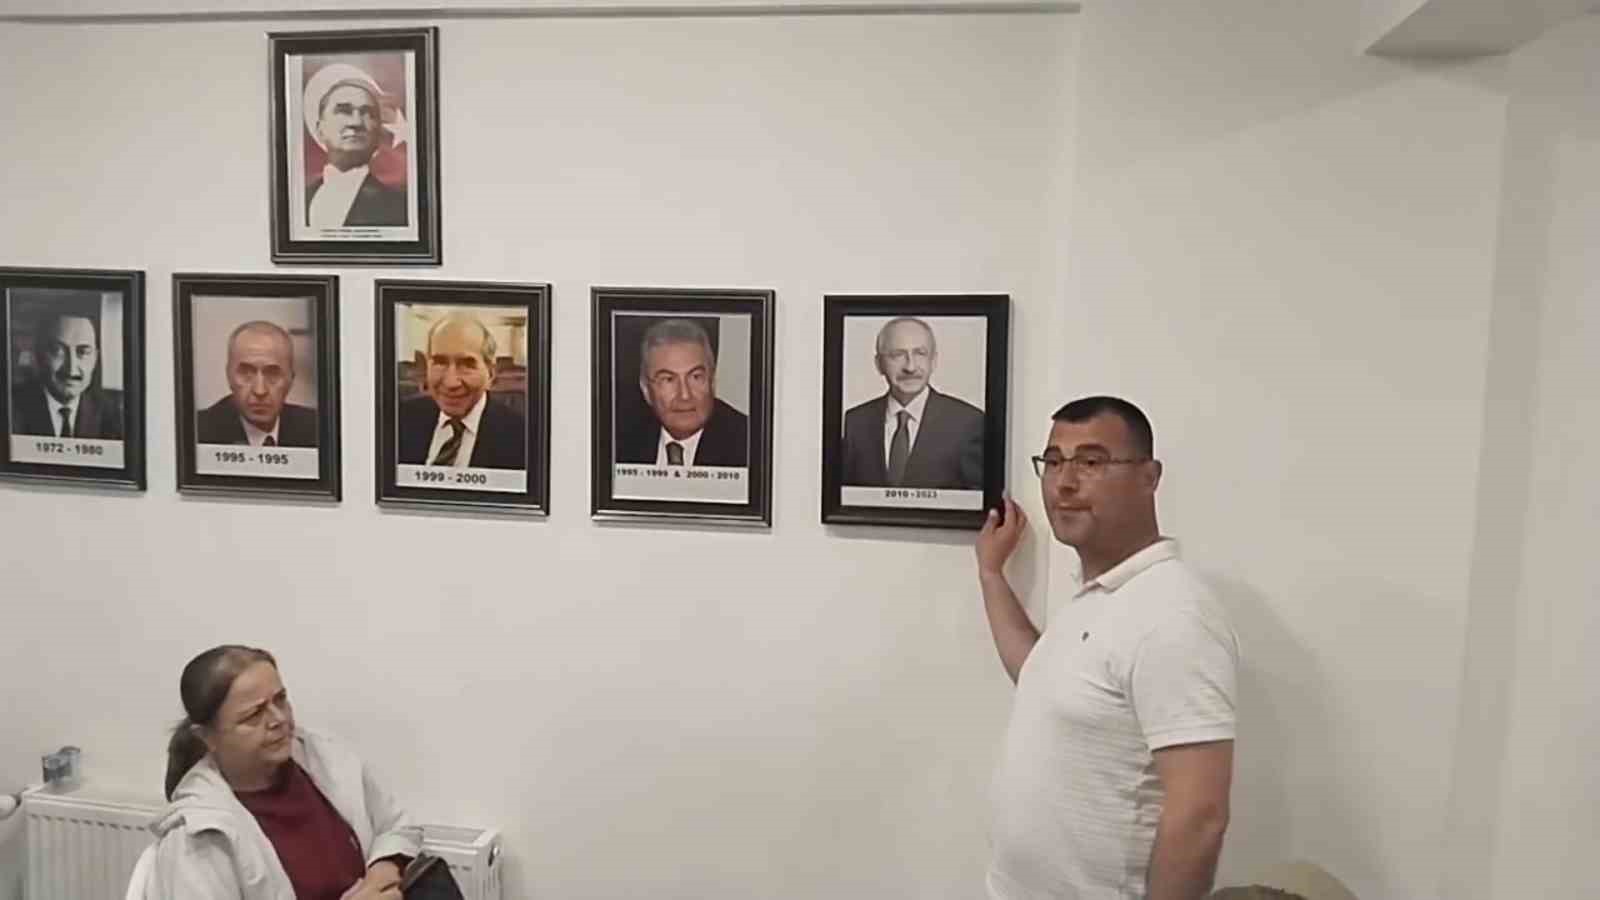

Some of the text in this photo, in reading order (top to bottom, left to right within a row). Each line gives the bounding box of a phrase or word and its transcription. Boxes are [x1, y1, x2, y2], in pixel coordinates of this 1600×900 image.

[36, 442, 64, 453] 1972
[215, 452, 245, 462] 1995
[258, 454, 288, 464] 1995
[415, 471, 445, 482] 1999
[456, 473, 487, 484] 2000
[674, 470, 681, 478] &
